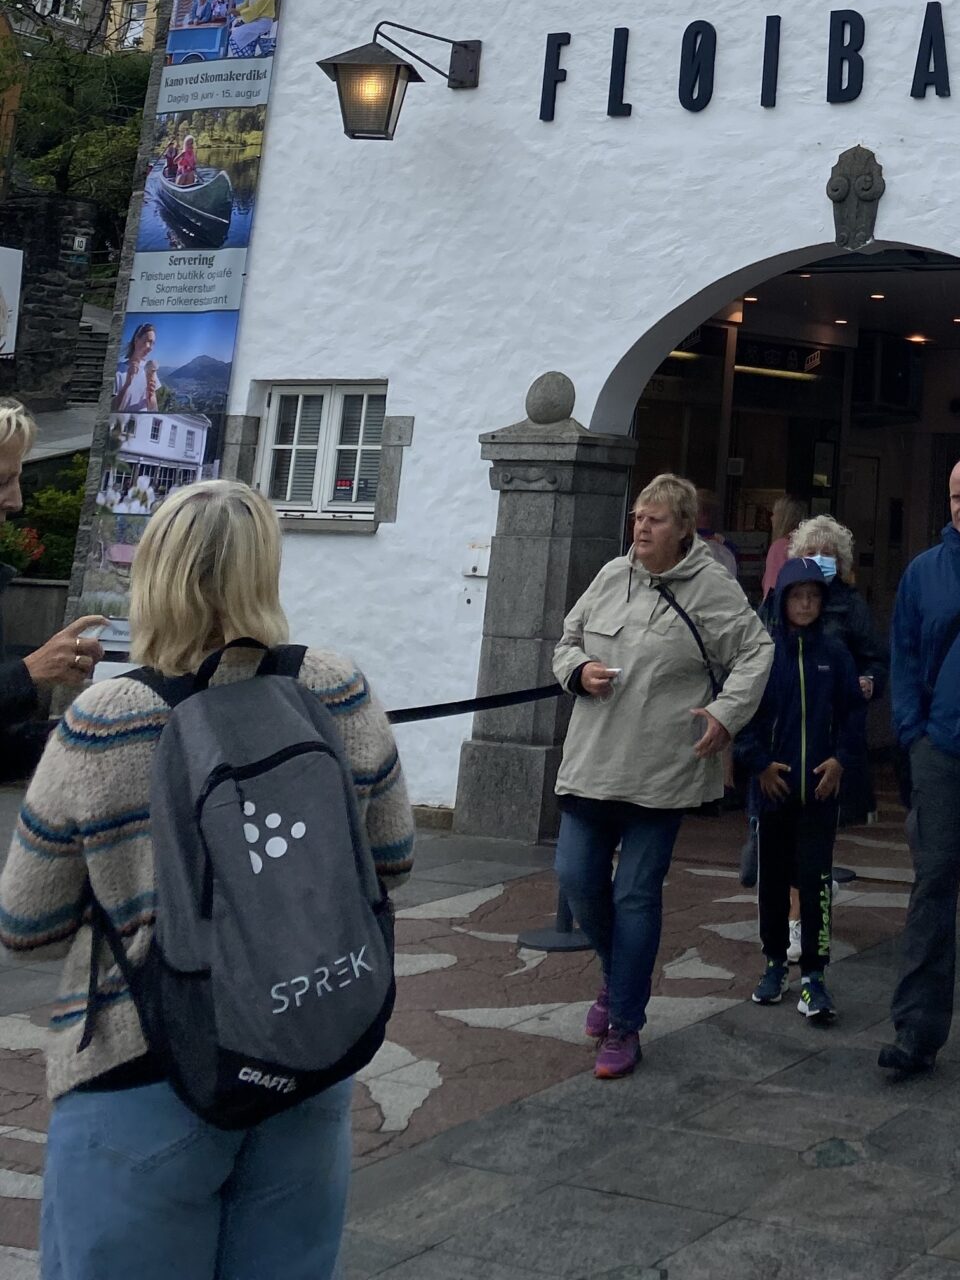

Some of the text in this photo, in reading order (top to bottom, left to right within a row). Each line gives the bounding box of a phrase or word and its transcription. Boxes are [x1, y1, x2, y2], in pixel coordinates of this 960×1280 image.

[164, 77, 184, 88] Kano
[184, 74, 199, 85] ved
[167, 93, 189, 104] Daglig
[168, 254, 216, 268] Servering
[140, 271, 176, 281] Fløistuen
[177, 270, 205, 280] butikk
[141, 296, 165, 307] Fløien
[270, 945, 373, 1014] SPREK
[238, 1066, 289, 1092] CRAFT
